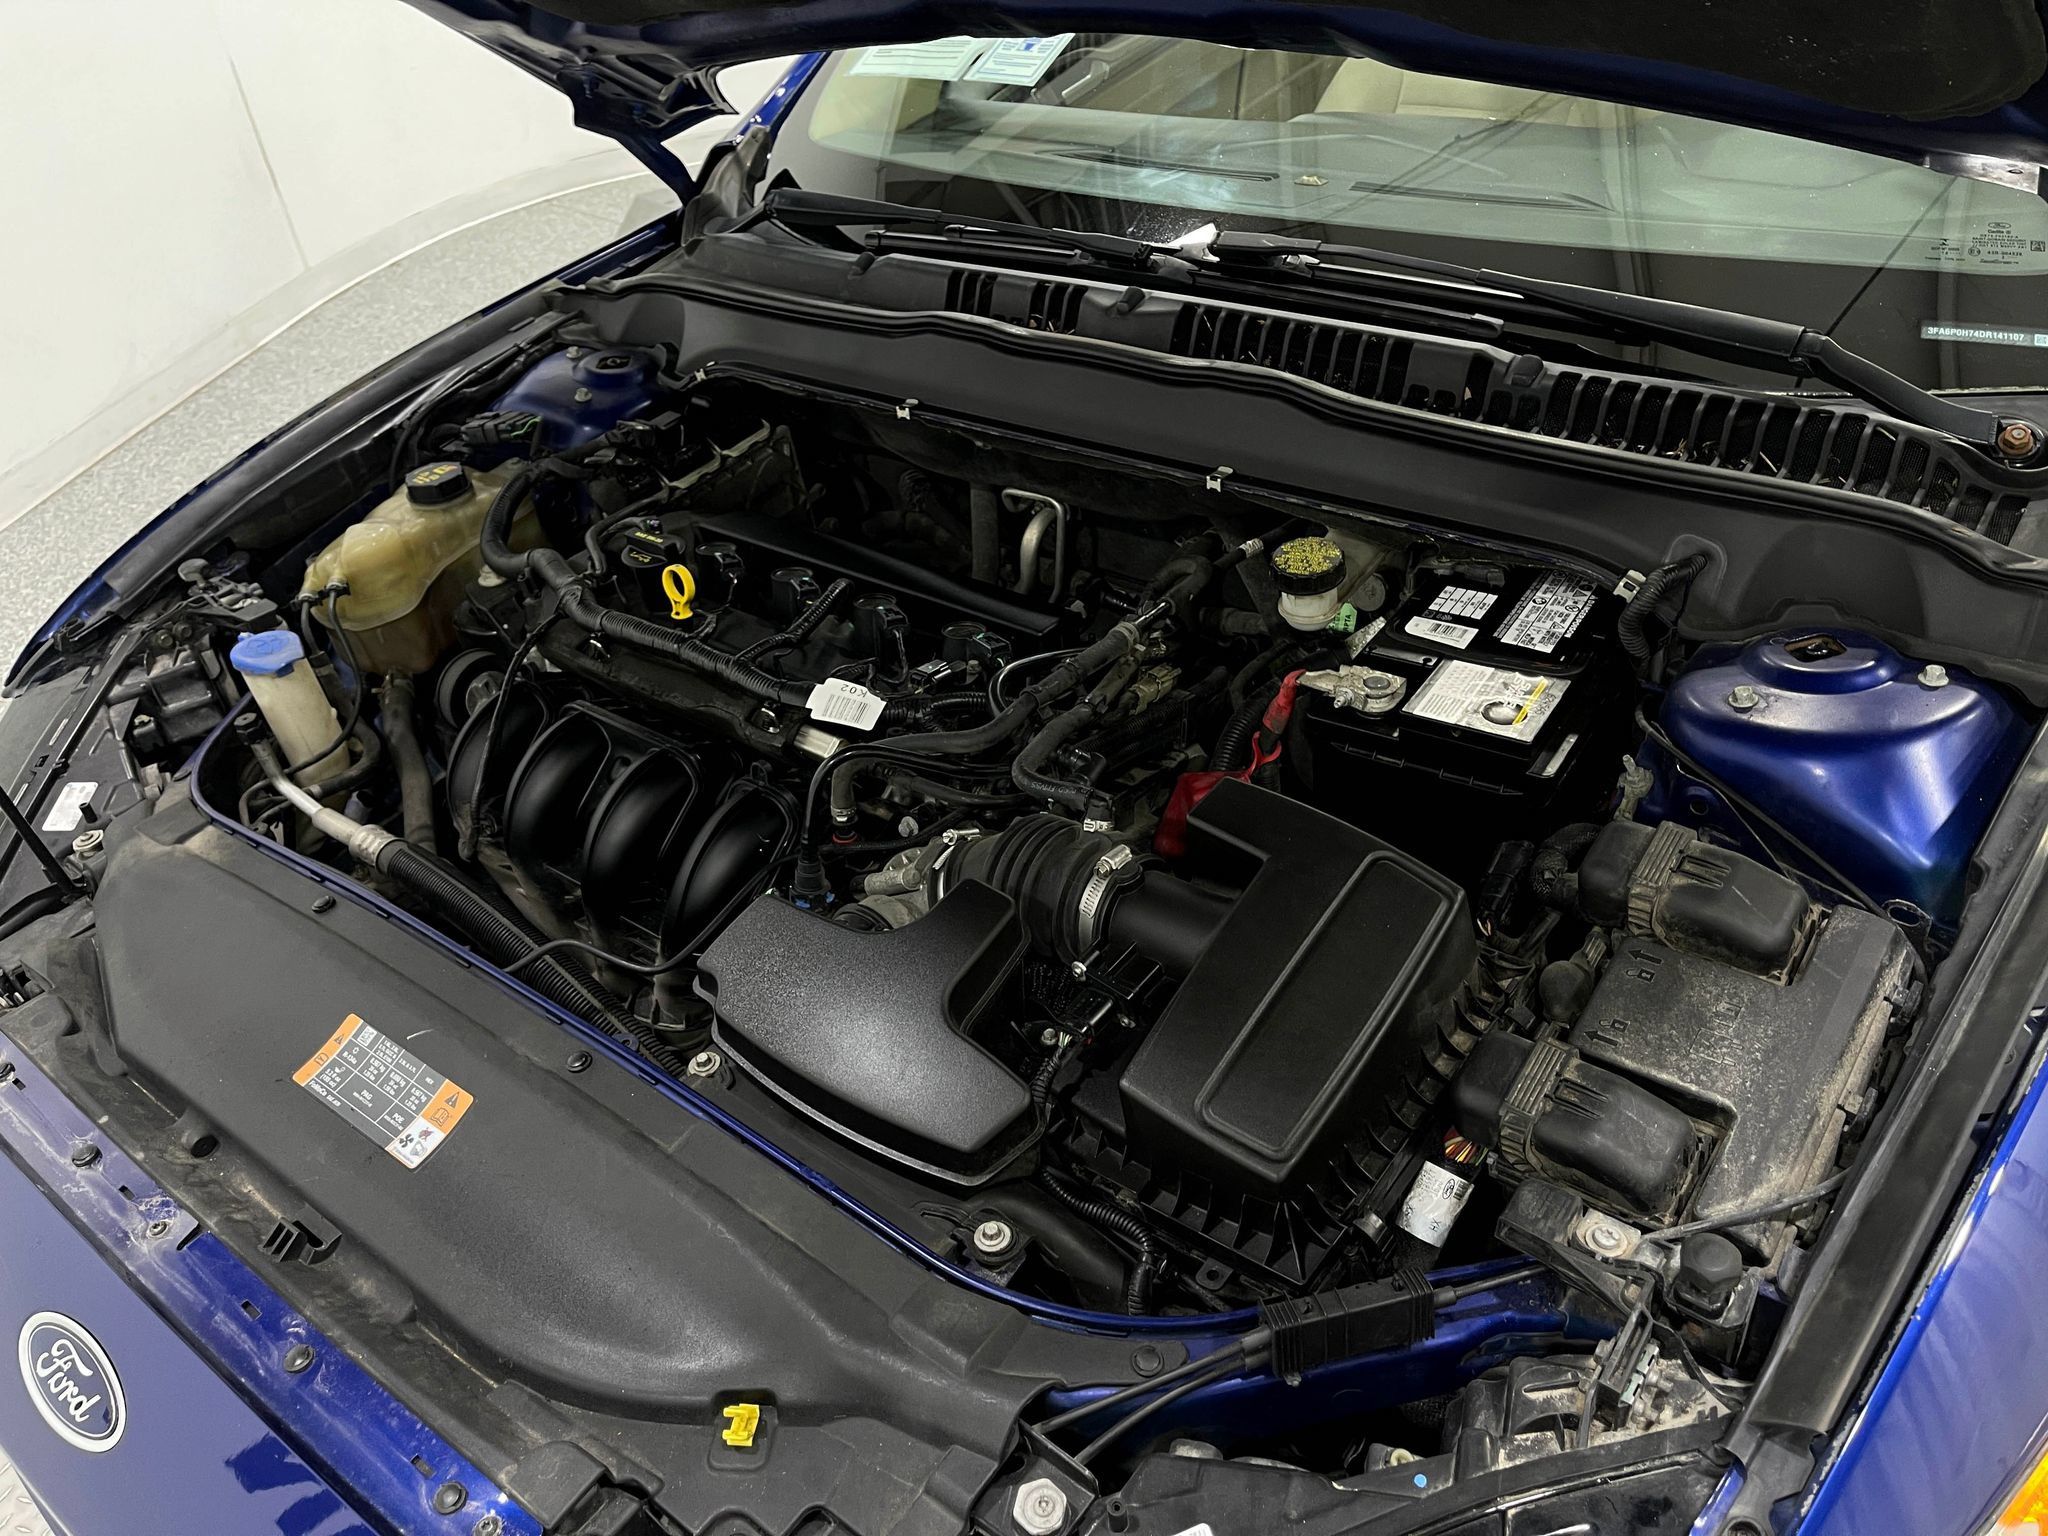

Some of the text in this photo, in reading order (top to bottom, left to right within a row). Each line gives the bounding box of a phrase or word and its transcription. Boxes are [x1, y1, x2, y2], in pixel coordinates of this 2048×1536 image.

[1927, 326, 2025, 341] 3FA6P0H74DR141107
[840, 683, 868, 698] K02
[308, 1079, 328, 1096] FoMoCo
[359, 1089, 373, 1100] PAG
[391, 1112, 405, 1124] POE
[36, 1338, 101, 1423] Ford
